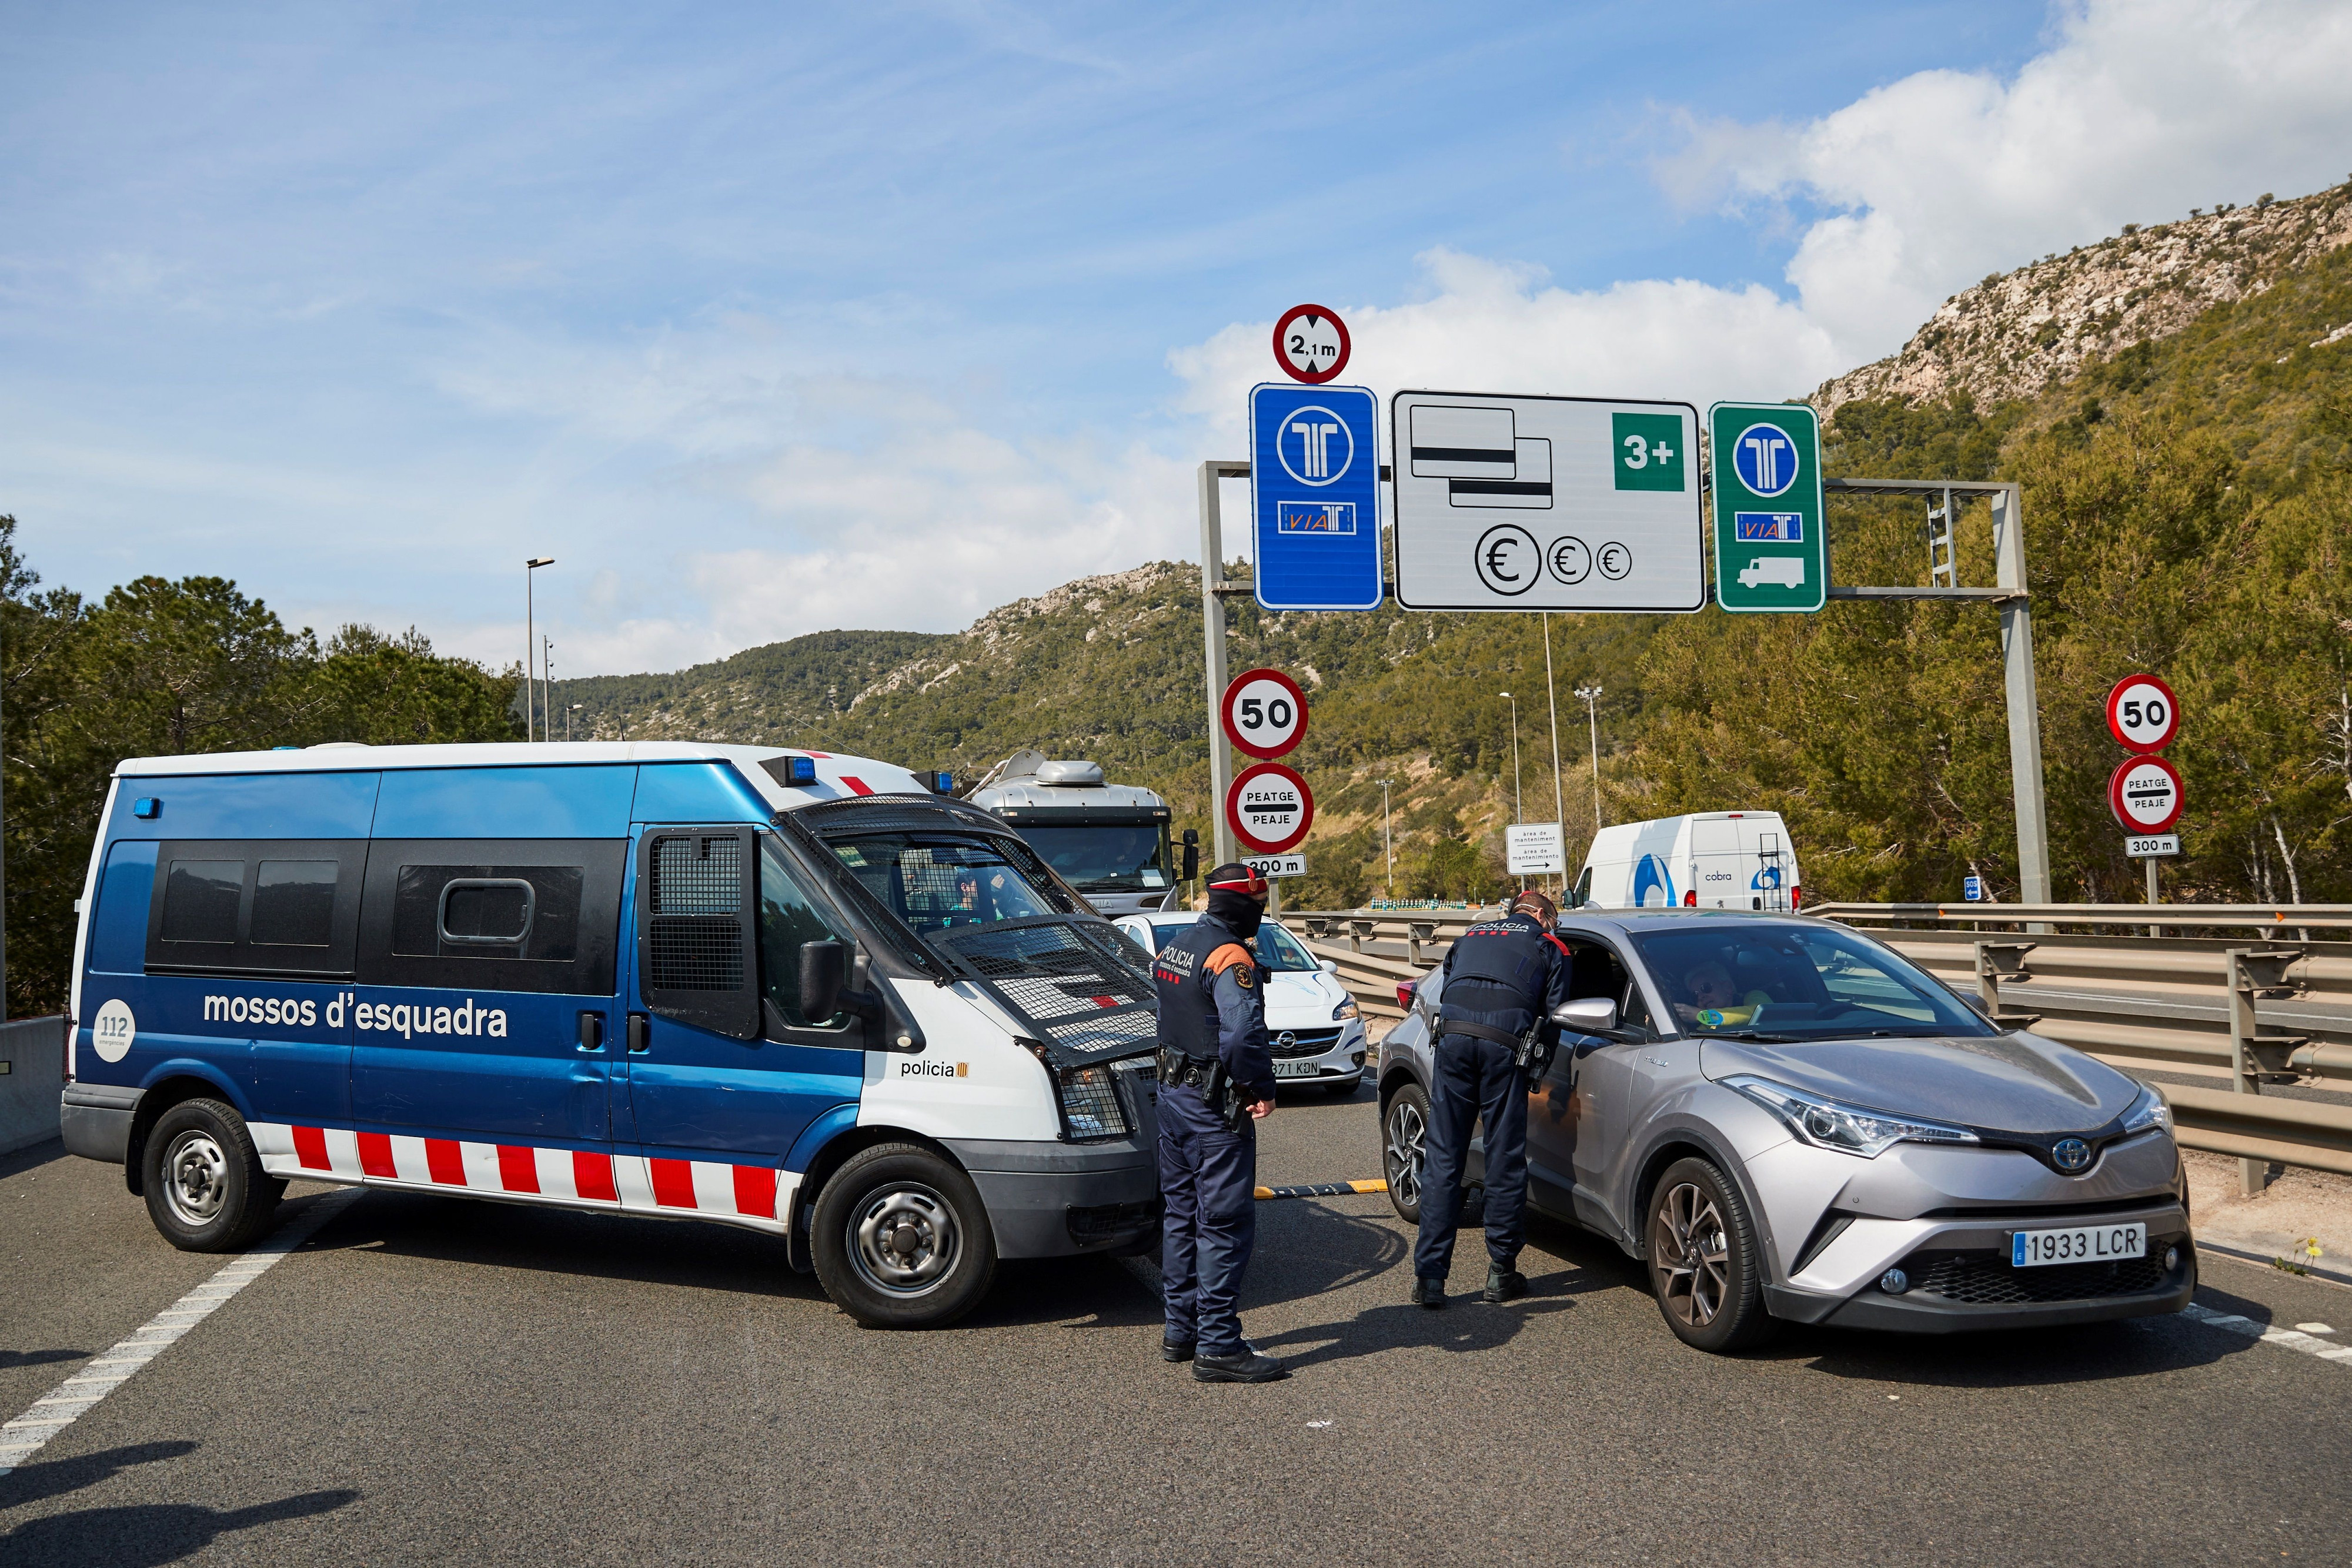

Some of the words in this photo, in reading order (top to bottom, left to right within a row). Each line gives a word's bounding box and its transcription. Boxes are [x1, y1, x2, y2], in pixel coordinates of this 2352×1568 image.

[1623, 434, 1673, 469] 3+
[1241, 698, 1291, 730] 50
[2124, 700, 2166, 728] 50
[2129, 778, 2167, 789] PEATGE
[1247, 791, 1294, 802] PEATGE
[2134, 798, 2166, 808] PEAJE
[1252, 814, 1291, 825] PEAJE
[2133, 840, 2159, 852] 300
[2162, 841, 2172, 850] m
[1286, 861, 1298, 871] m
[1705, 870, 1732, 881] cobra
[1161, 945, 1195, 969] POLICIA
[203, 994, 316, 1027] mossos
[326, 991, 507, 1039] d'esquadra
[100, 1016, 128, 1038] 112
[901, 1060, 954, 1077] policia
[1297, 1062, 1318, 1074] KDN
[2032, 1232, 2086, 1261] 1933
[2096, 1228, 2137, 1256] LCR
